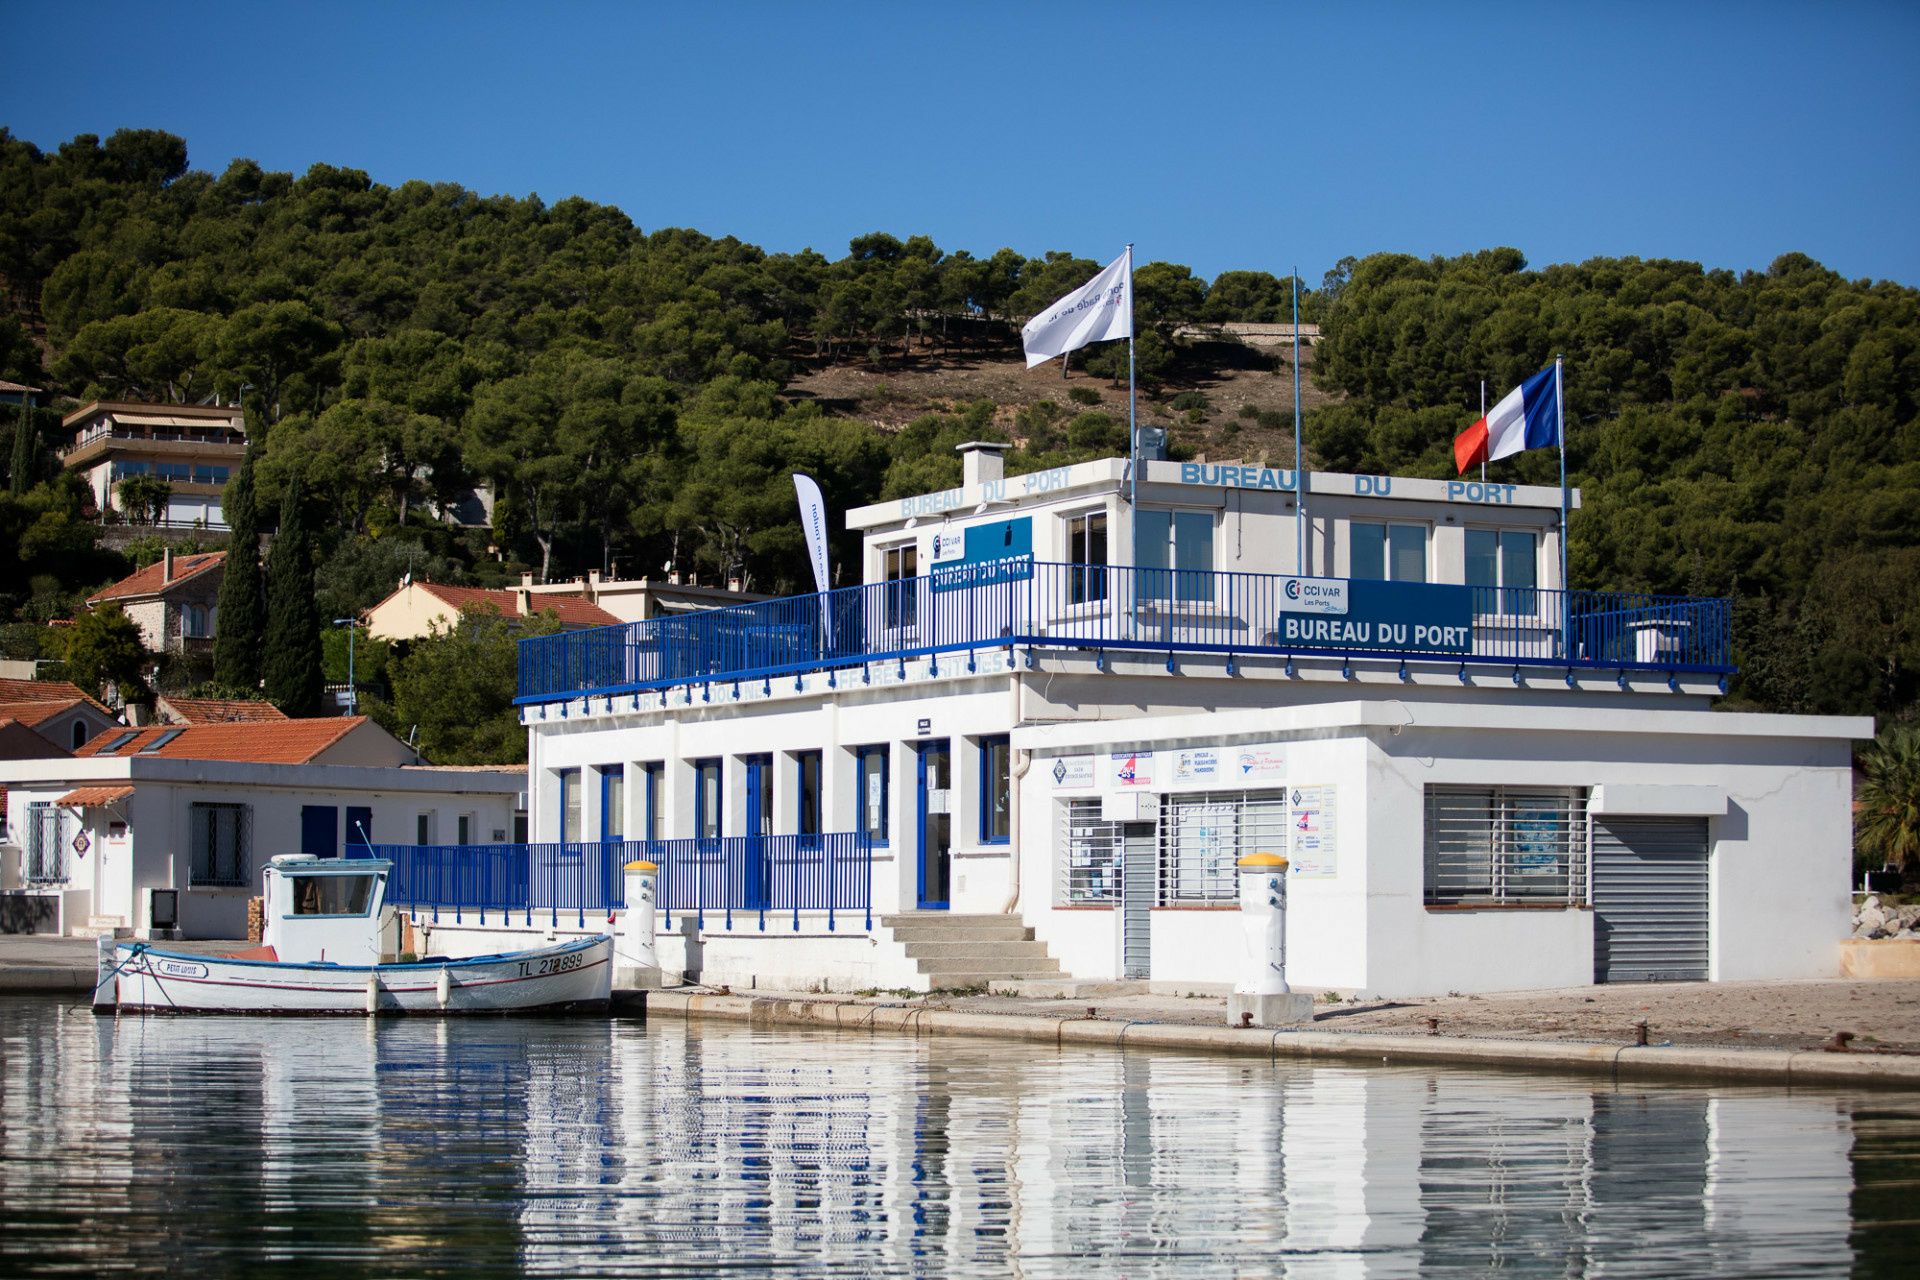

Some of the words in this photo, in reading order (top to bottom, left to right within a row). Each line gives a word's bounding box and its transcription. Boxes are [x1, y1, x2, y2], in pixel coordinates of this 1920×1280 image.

[901, 487, 965, 518] BUREAU
[982, 479, 1006, 501] DU
[1026, 466, 1072, 495] PORT
[1181, 463, 1297, 492] BUREAU
[1355, 475, 1392, 496] DU
[1447, 481, 1517, 504] PORT
[1304, 585, 1320, 597] CCI
[1322, 587, 1340, 598] VAR
[1285, 618, 1370, 643] BUREAU
[1378, 622, 1407, 644] DU
[1414, 625, 1469, 647] PORT
[518, 962, 533, 976] TL
